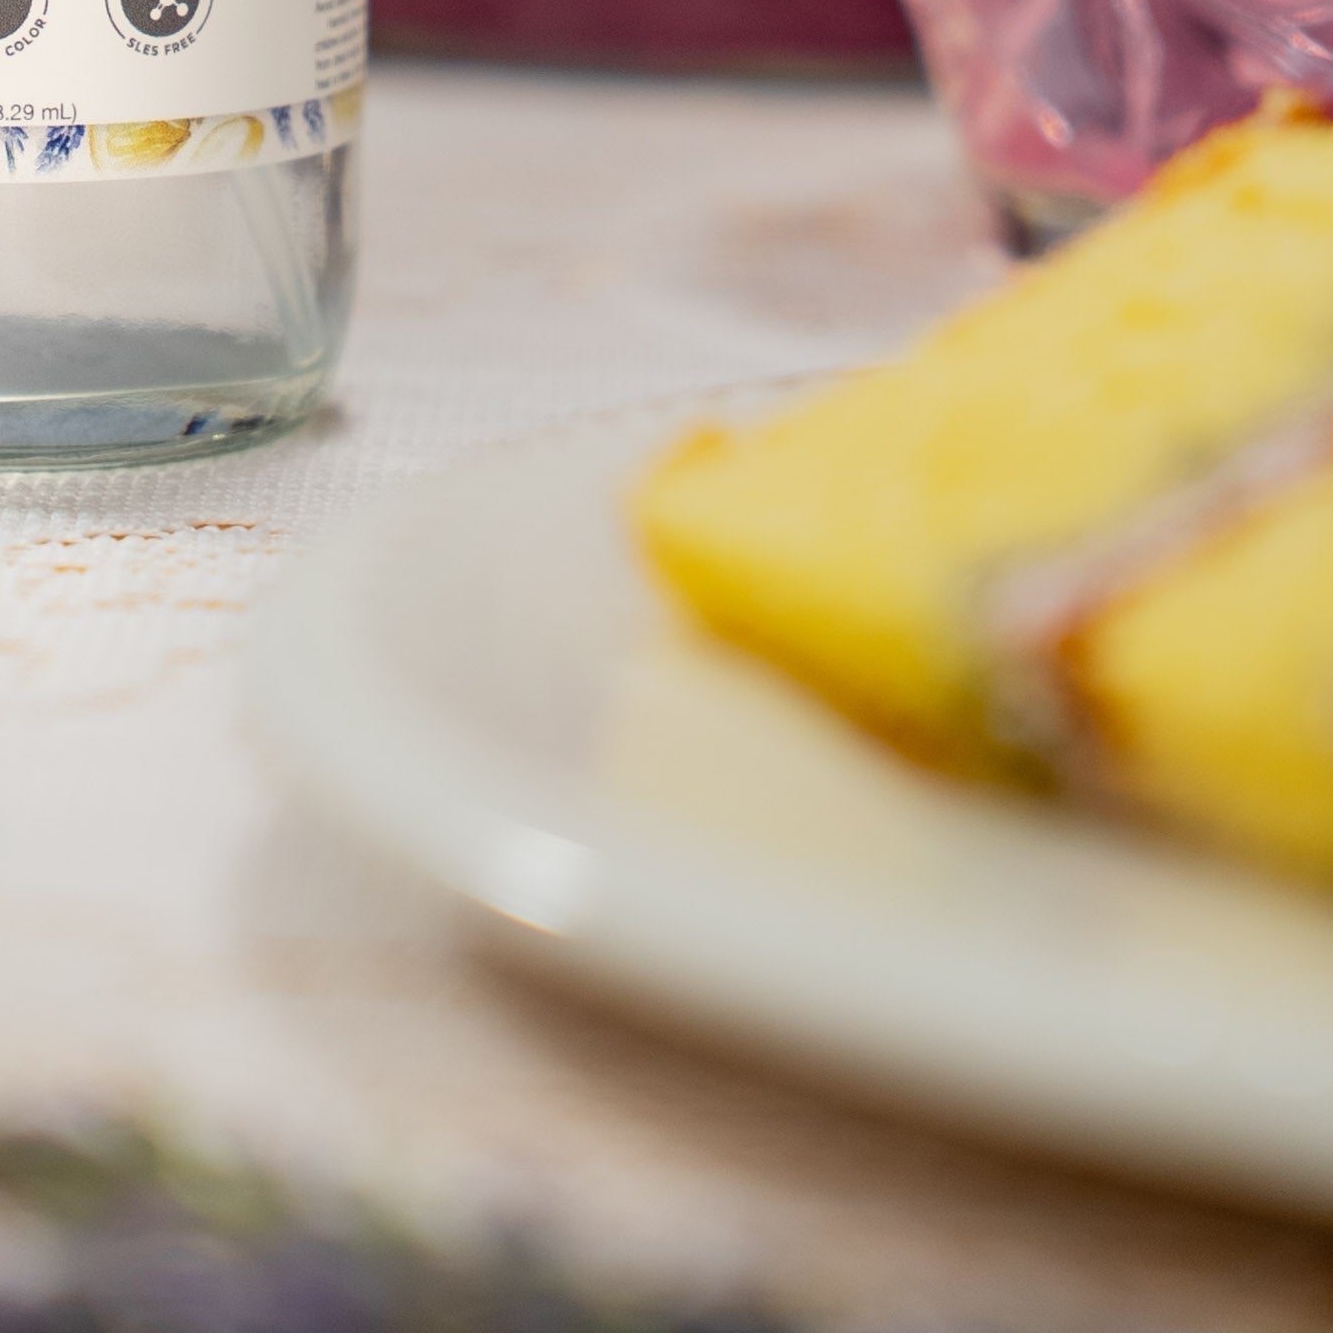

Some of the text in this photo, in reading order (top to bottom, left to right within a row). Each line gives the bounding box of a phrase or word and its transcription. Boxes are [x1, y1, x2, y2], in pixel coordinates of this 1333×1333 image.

[5, 18, 47, 57] COLOR
[126, 32, 197, 56] SLES FREE
[41, 103, 78, 124] mL)
